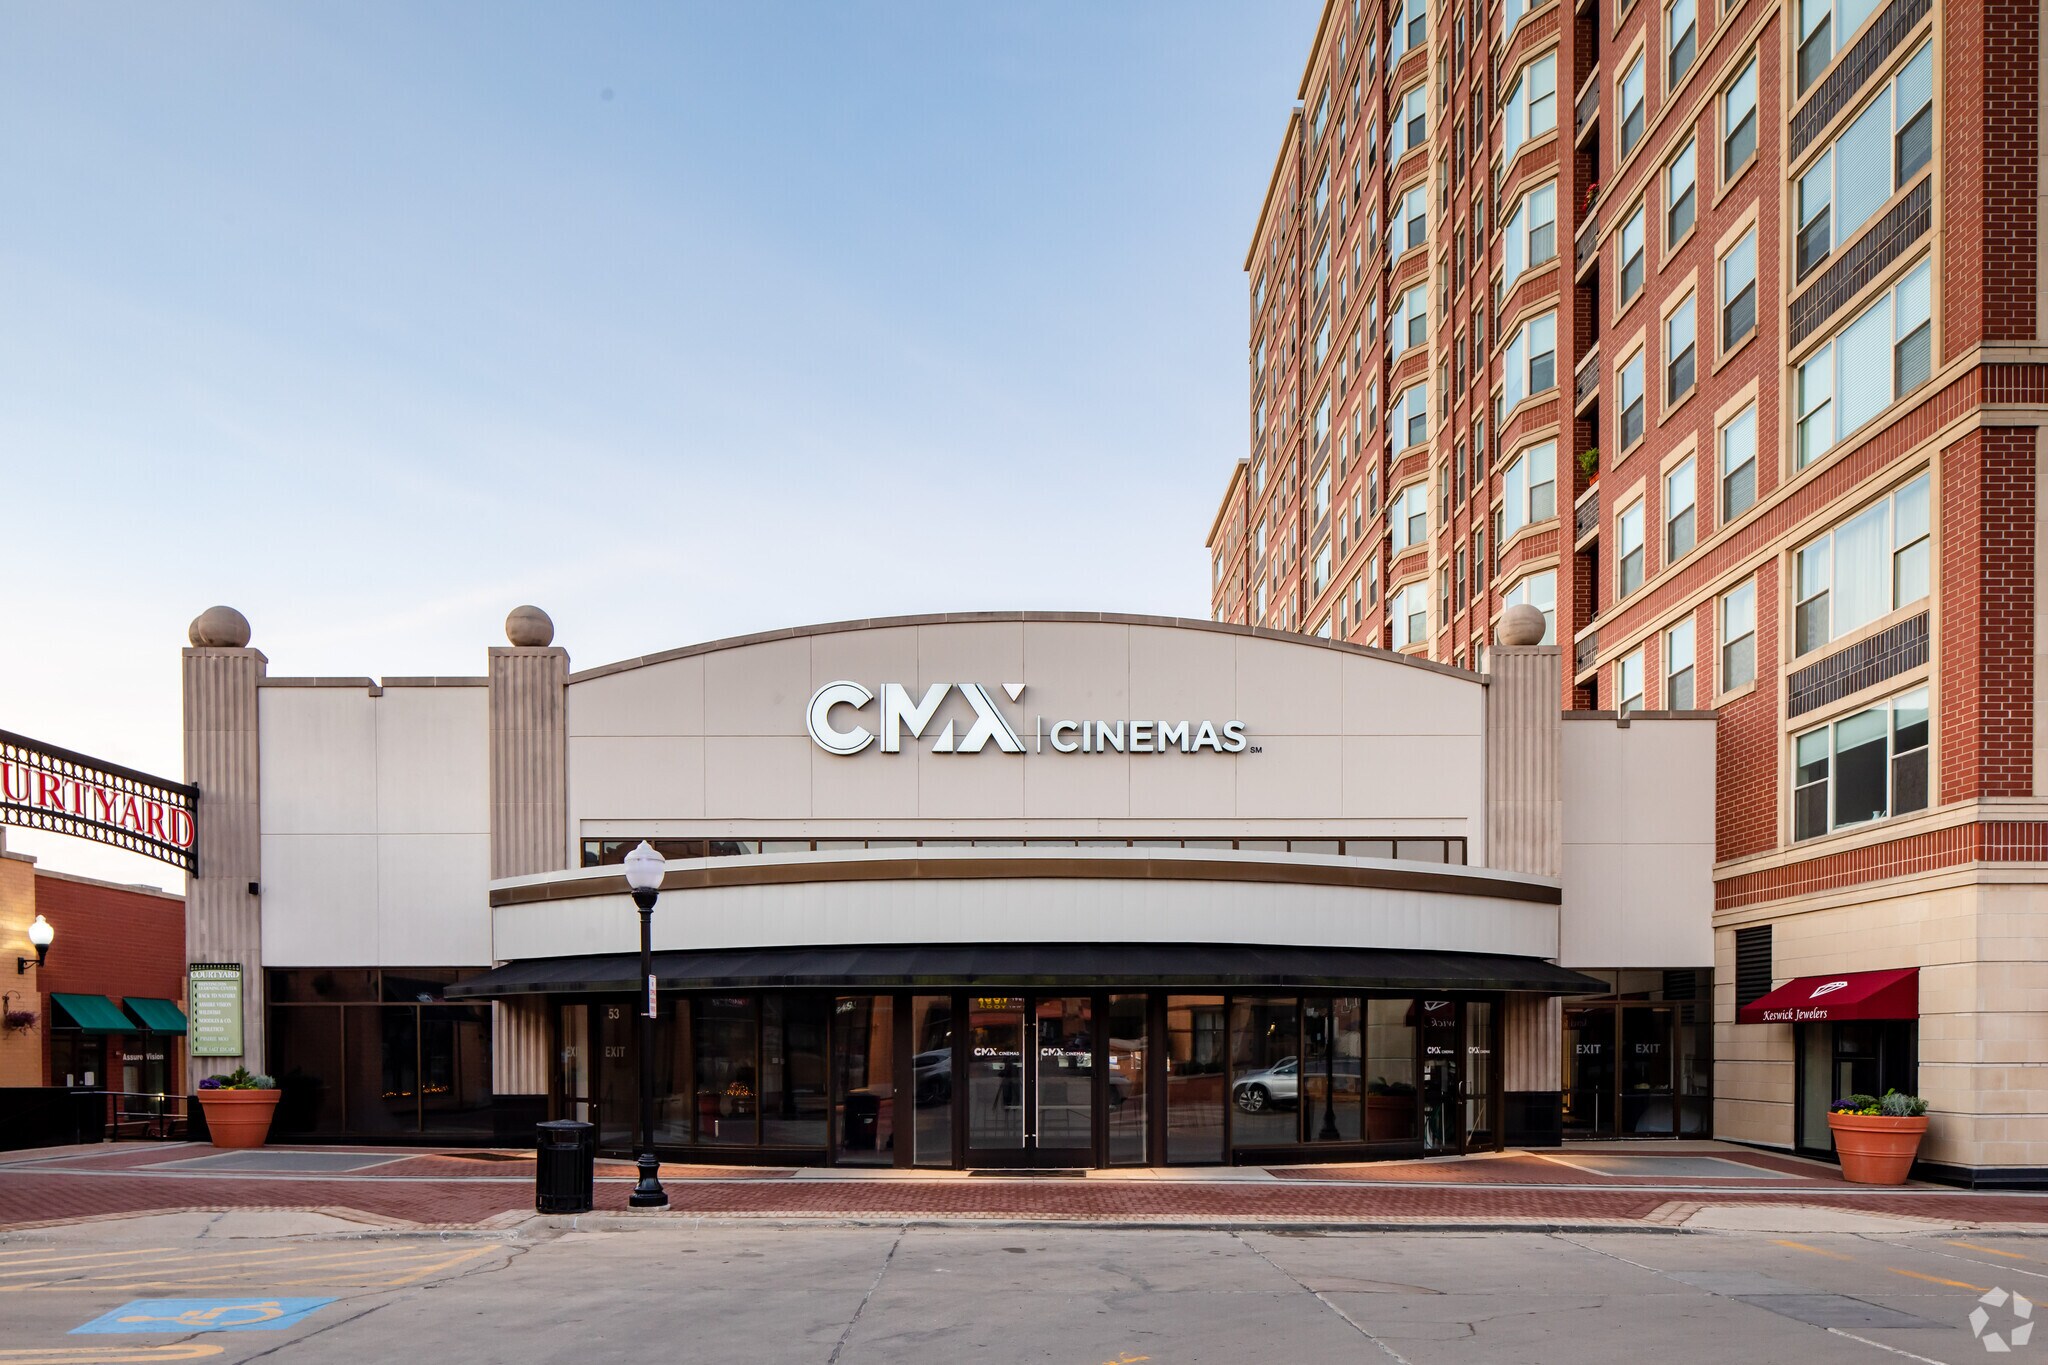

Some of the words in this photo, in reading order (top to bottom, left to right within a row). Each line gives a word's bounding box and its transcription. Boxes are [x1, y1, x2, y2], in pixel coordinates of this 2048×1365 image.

[806, 679, 1027, 755] CMX
[1049, 719, 1247, 754] CINEMAS
[608, 1008, 620, 1019] 53
[1763, 1009, 1793, 1021] Keswick
[1794, 1007, 1828, 1020] Jewelers
[605, 1046, 626, 1057] EXIT
[974, 1047, 997, 1056] CMX
[1041, 1047, 1064, 1056] CMX
[1576, 1044, 1602, 1054] EXIT
[1635, 1043, 1661, 1054] EXIT
[122, 1053, 144, 1061] Assure
[146, 1052, 164, 1060] Vision
